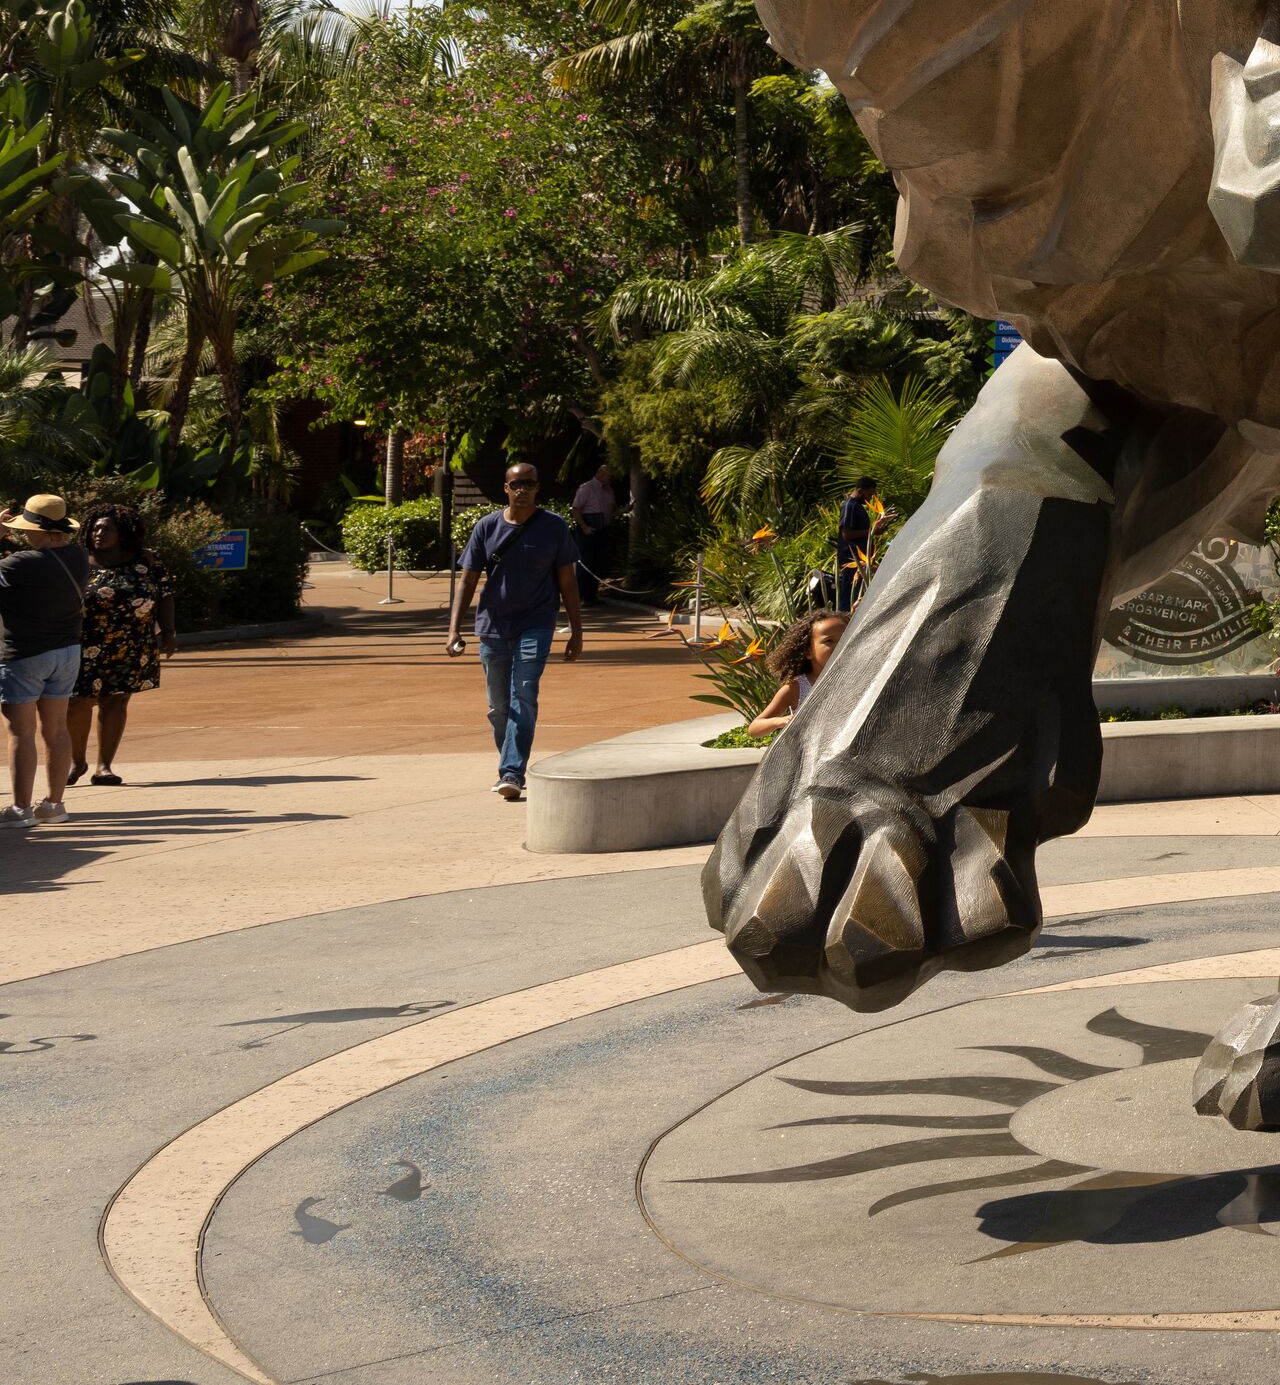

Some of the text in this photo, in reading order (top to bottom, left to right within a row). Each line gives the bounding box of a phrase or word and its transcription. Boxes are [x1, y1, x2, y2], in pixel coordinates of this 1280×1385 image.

[1135, 593, 1164, 604] GAR
[1175, 597, 1210, 612] MARK
[1195, 567, 1216, 585] GIFT
[1214, 584, 1234, 611] FROM
[1122, 617, 1252, 649] & THEIR FAMILIE
